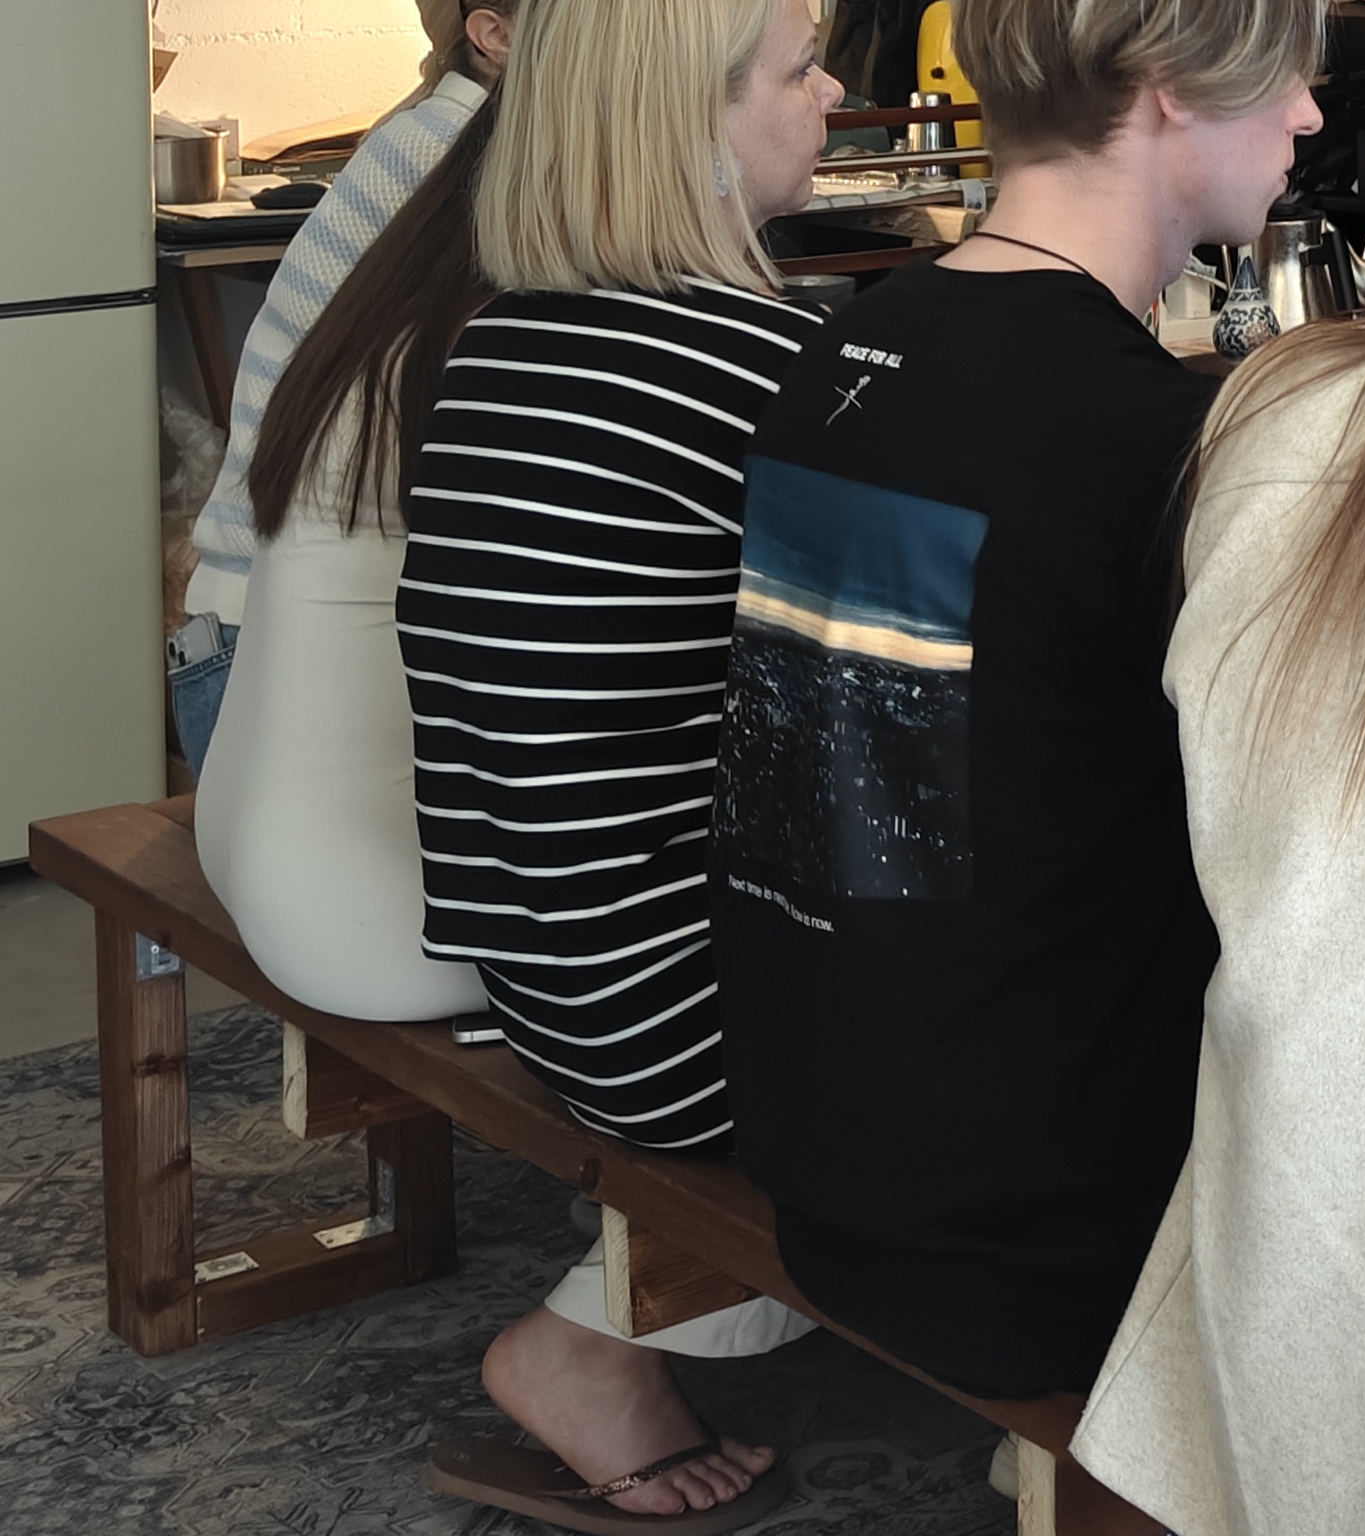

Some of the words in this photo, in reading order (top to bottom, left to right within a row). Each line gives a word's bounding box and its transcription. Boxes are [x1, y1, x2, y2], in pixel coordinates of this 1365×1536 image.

[840, 343, 870, 361] PEACE
[867, 349, 887, 365] FOR
[884, 353, 903, 369] ALL
[764, 886, 772, 900] is
